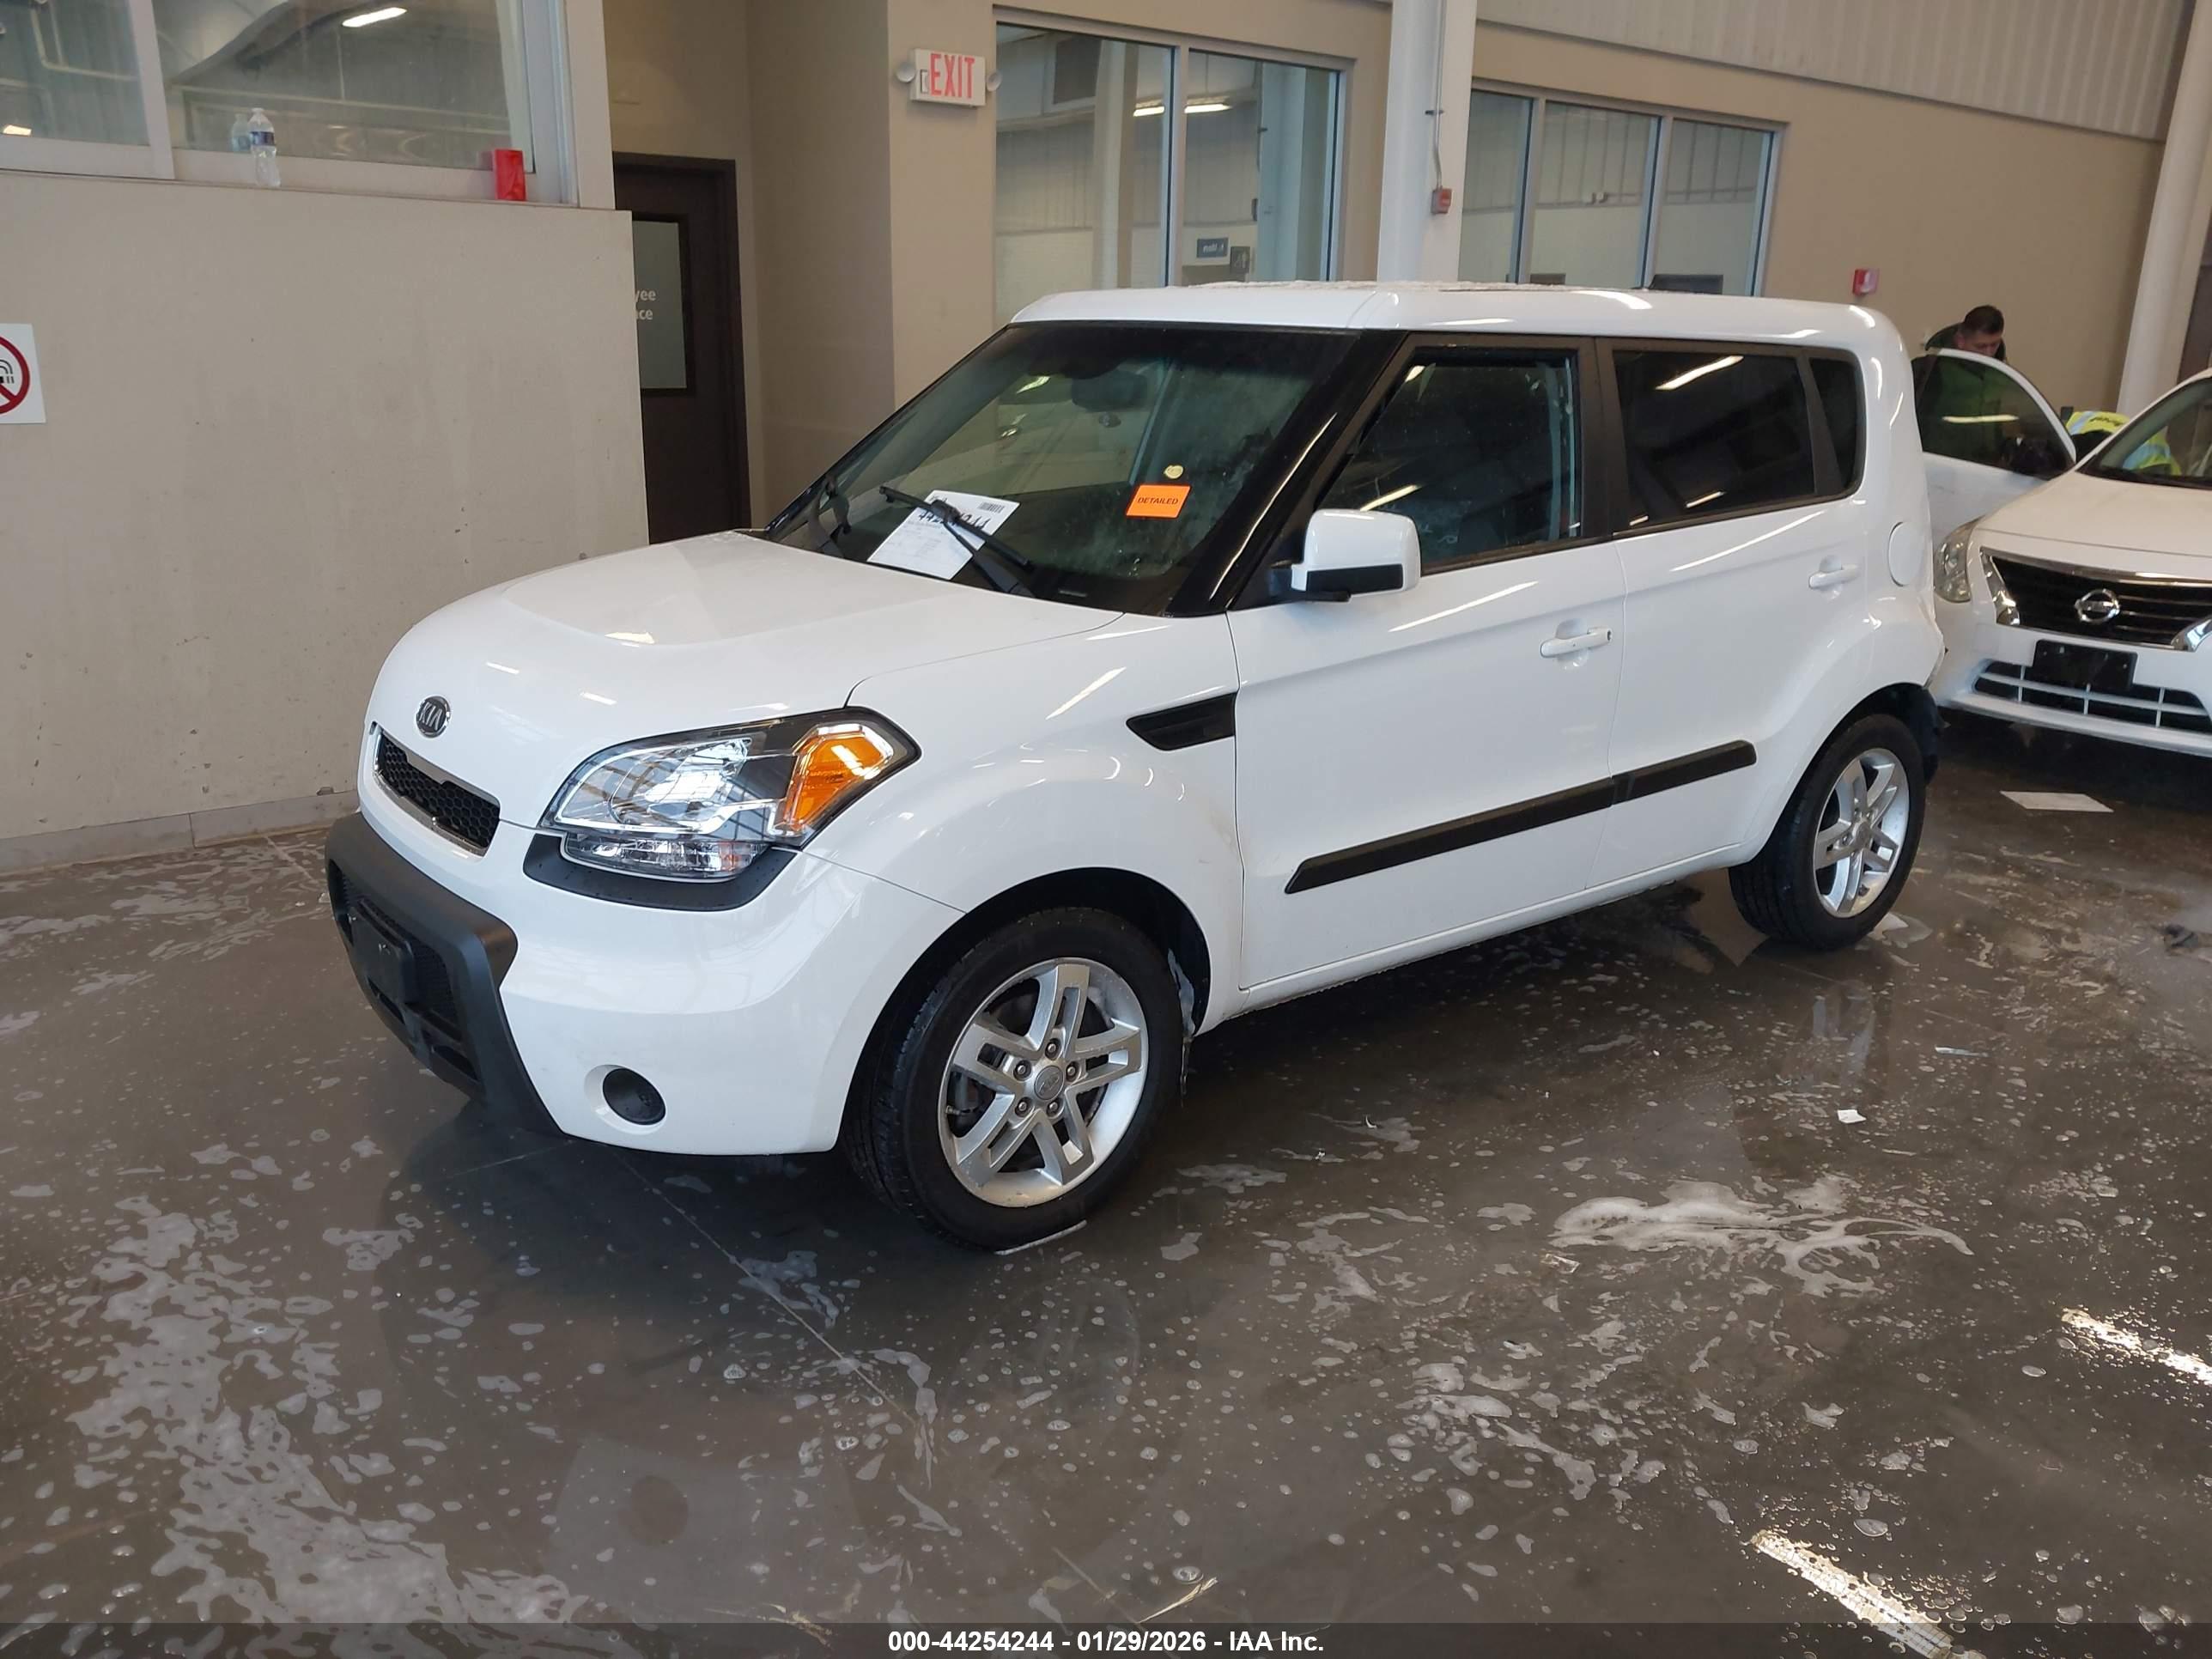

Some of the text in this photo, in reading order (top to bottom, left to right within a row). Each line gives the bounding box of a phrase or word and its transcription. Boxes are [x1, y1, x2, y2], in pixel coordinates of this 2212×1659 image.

[930, 53, 975, 99] EXIT
[1137, 496, 1179, 505] DETAILED
[419, 702, 443, 731] KIA
